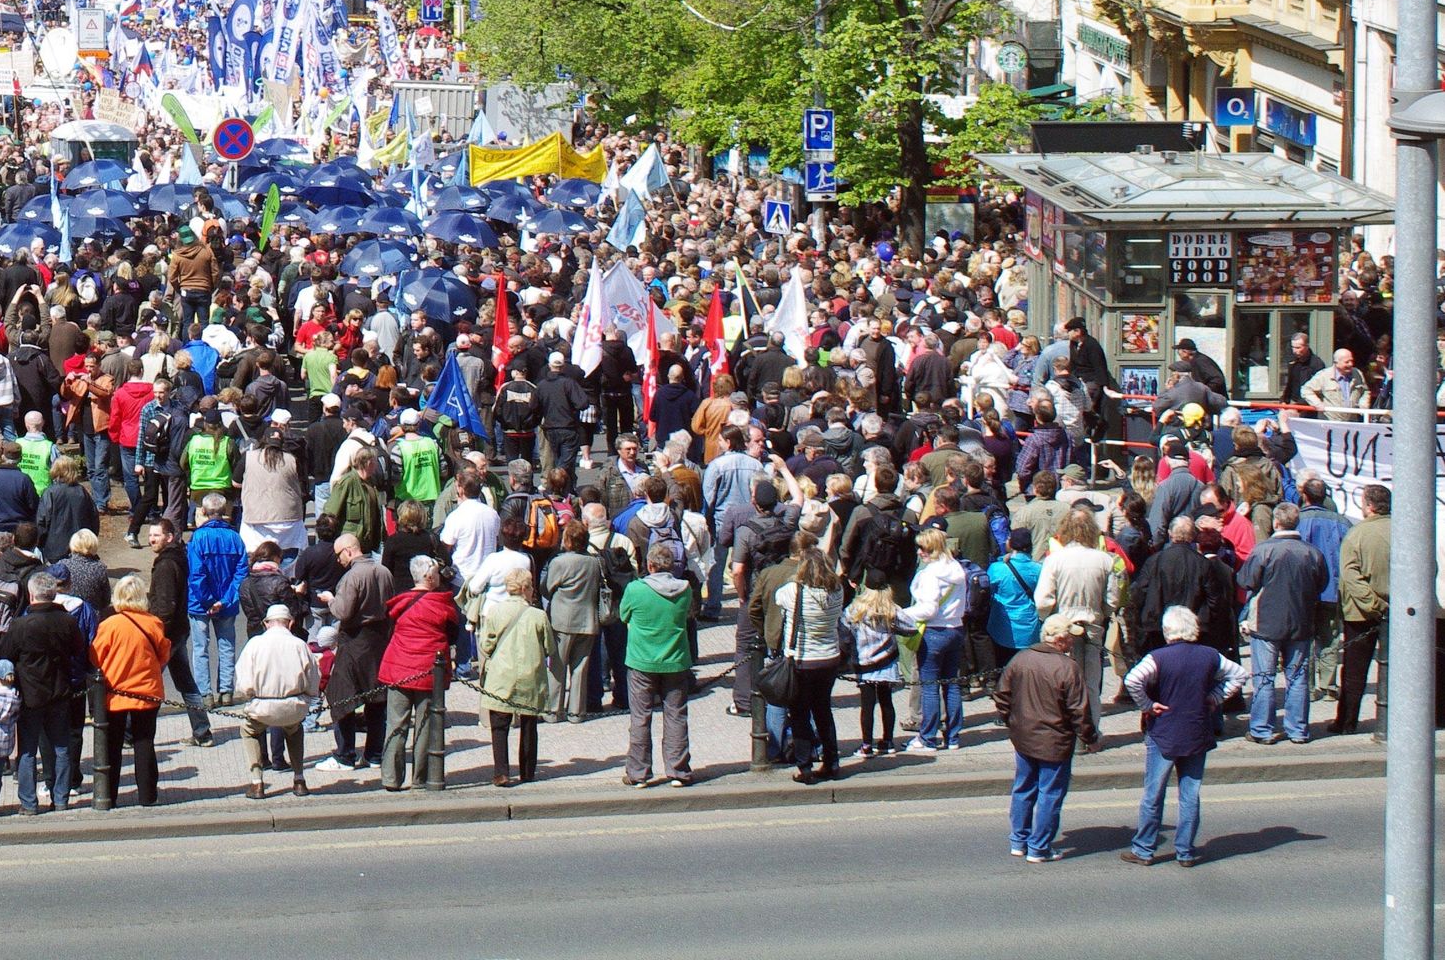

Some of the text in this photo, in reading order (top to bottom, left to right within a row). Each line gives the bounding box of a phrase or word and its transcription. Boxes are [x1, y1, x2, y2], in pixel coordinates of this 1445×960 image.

[810, 114, 828, 137] P
[1172, 232, 1228, 245] DOBRÉ
[1172, 243, 1227, 257] JÍDLO
[1172, 260, 1228, 271] GOOD
[1173, 272, 1228, 283] FOOD
